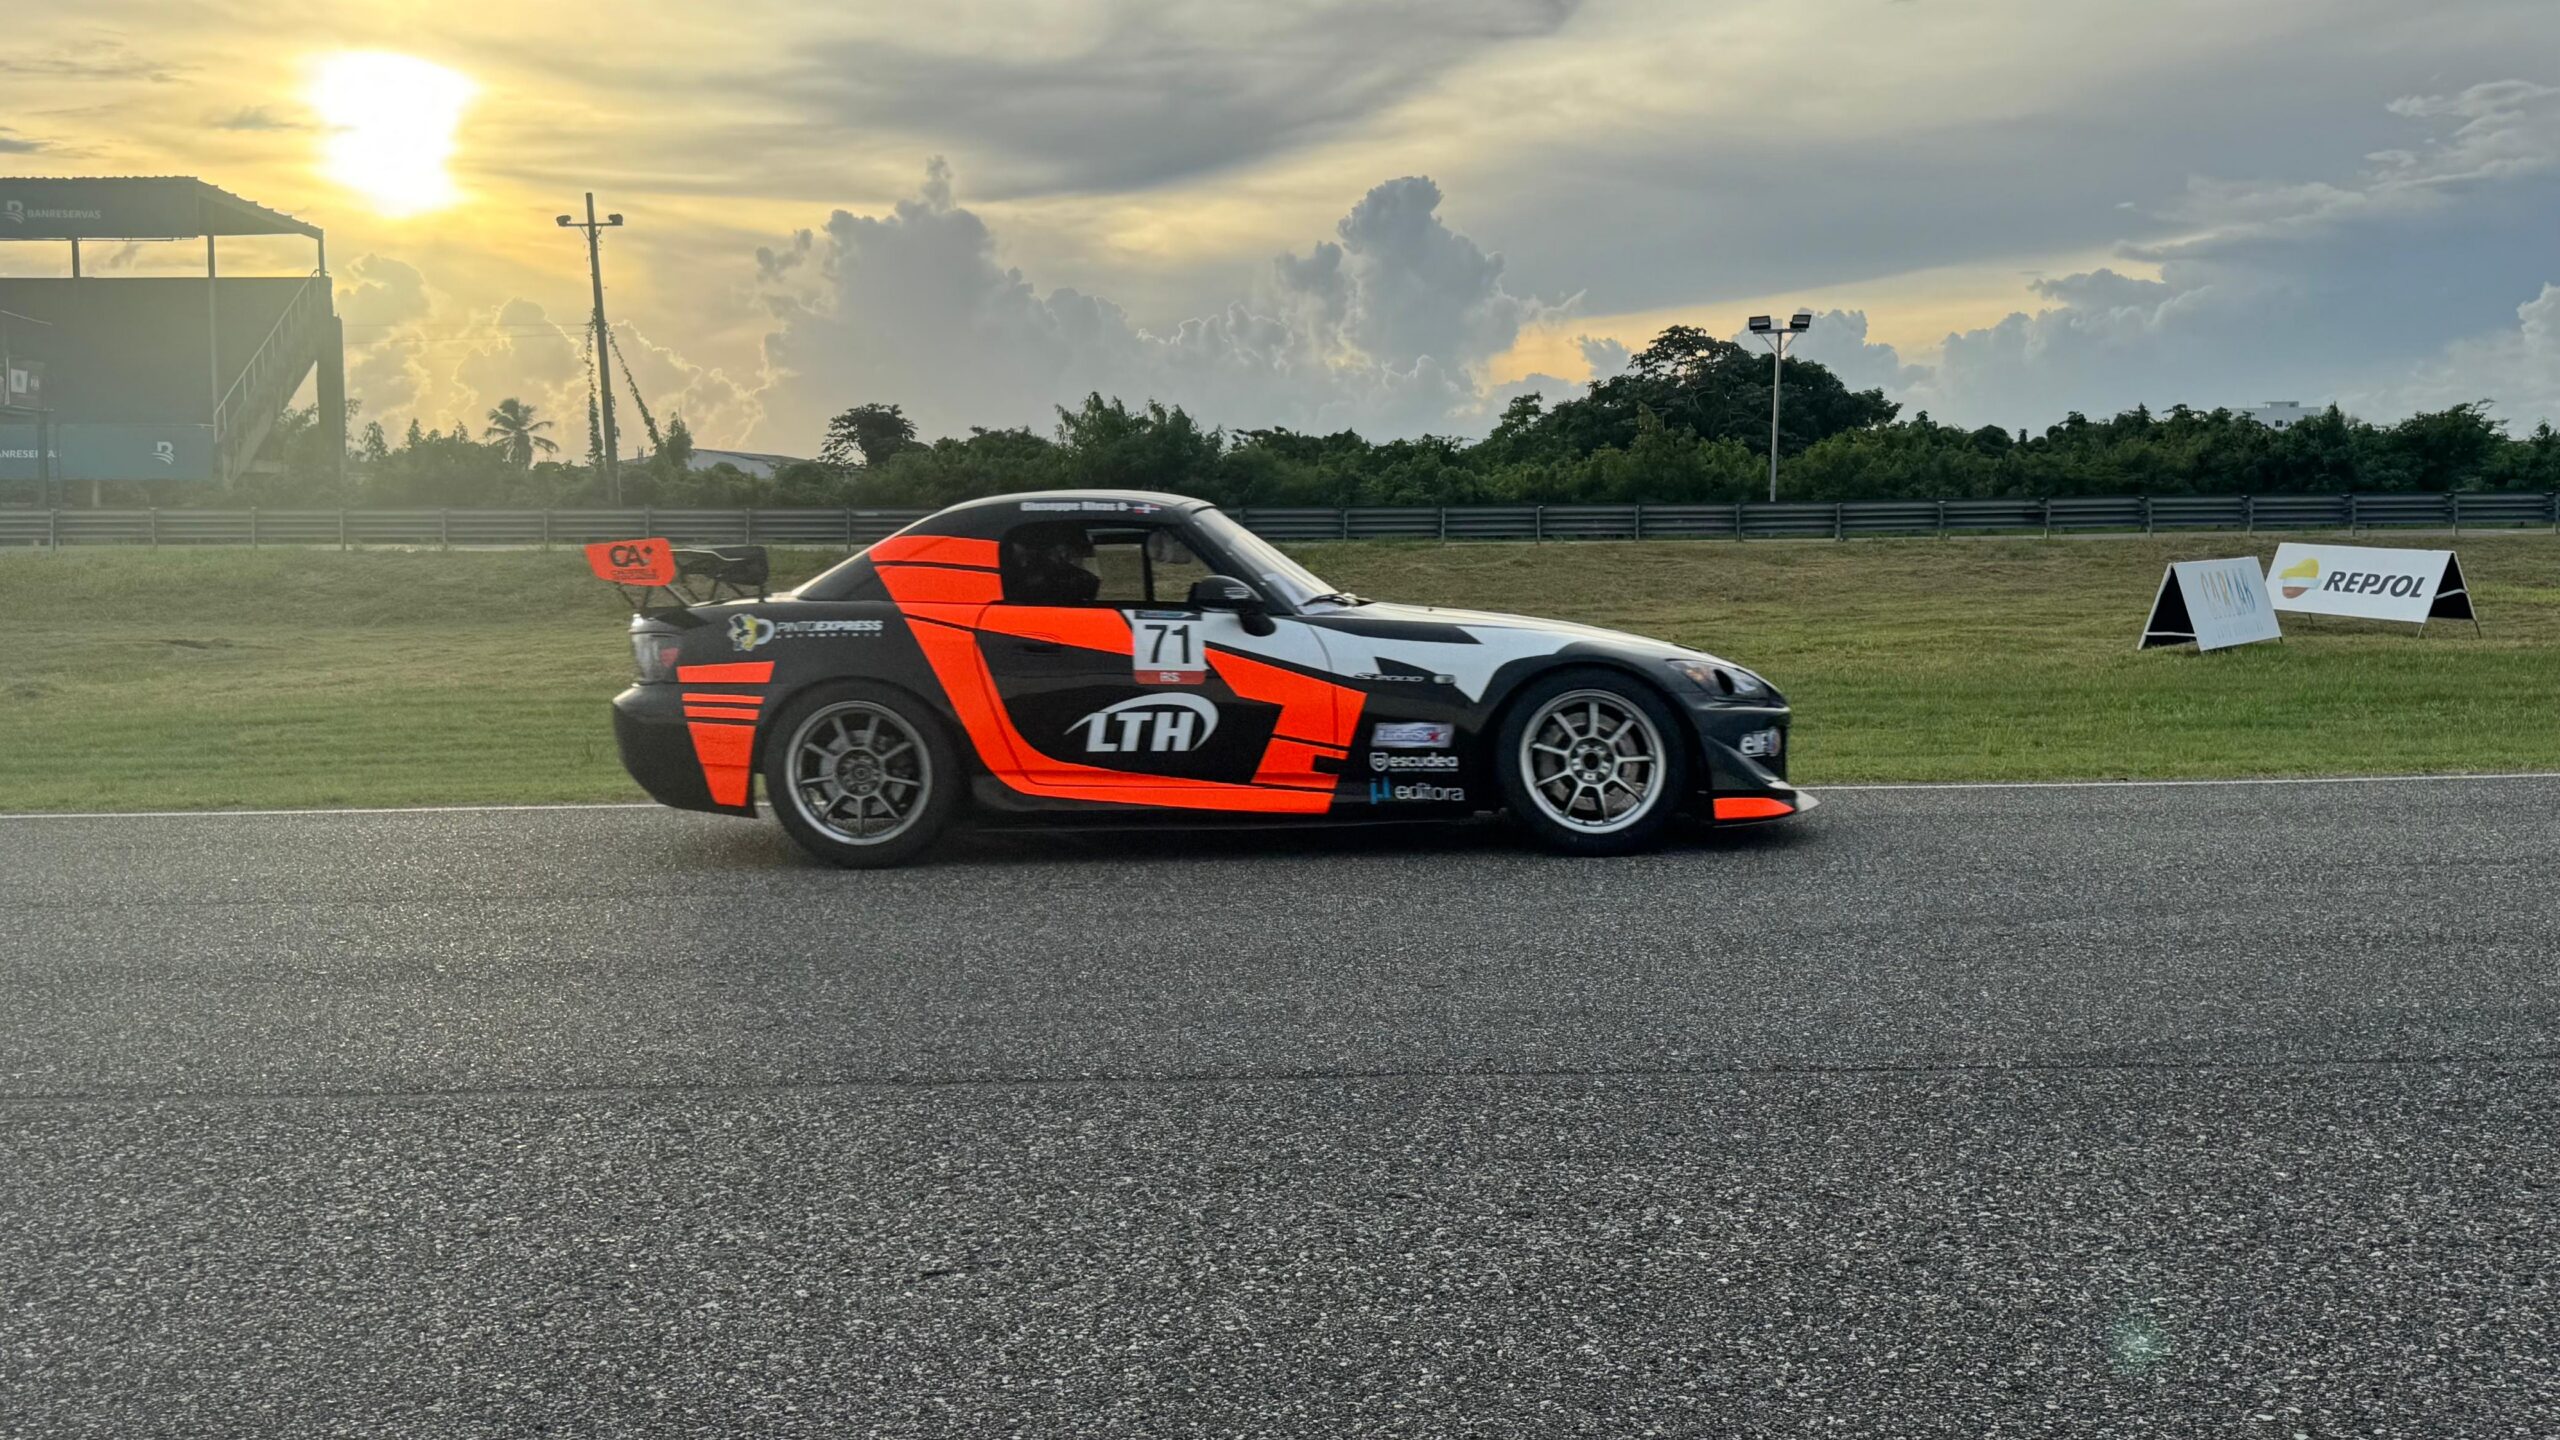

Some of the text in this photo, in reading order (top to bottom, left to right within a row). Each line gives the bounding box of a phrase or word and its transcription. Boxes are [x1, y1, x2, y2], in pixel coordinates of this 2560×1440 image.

[27, 208, 102, 219] BANRESERVAS
[2323, 571, 2425, 598] REPSOL
[1144, 624, 1191, 664] 71
[1160, 671, 1180, 682] RS
[1086, 711, 1196, 752] LTH
[1389, 752, 1459, 767] escudea
[1394, 782, 1465, 801] editora
